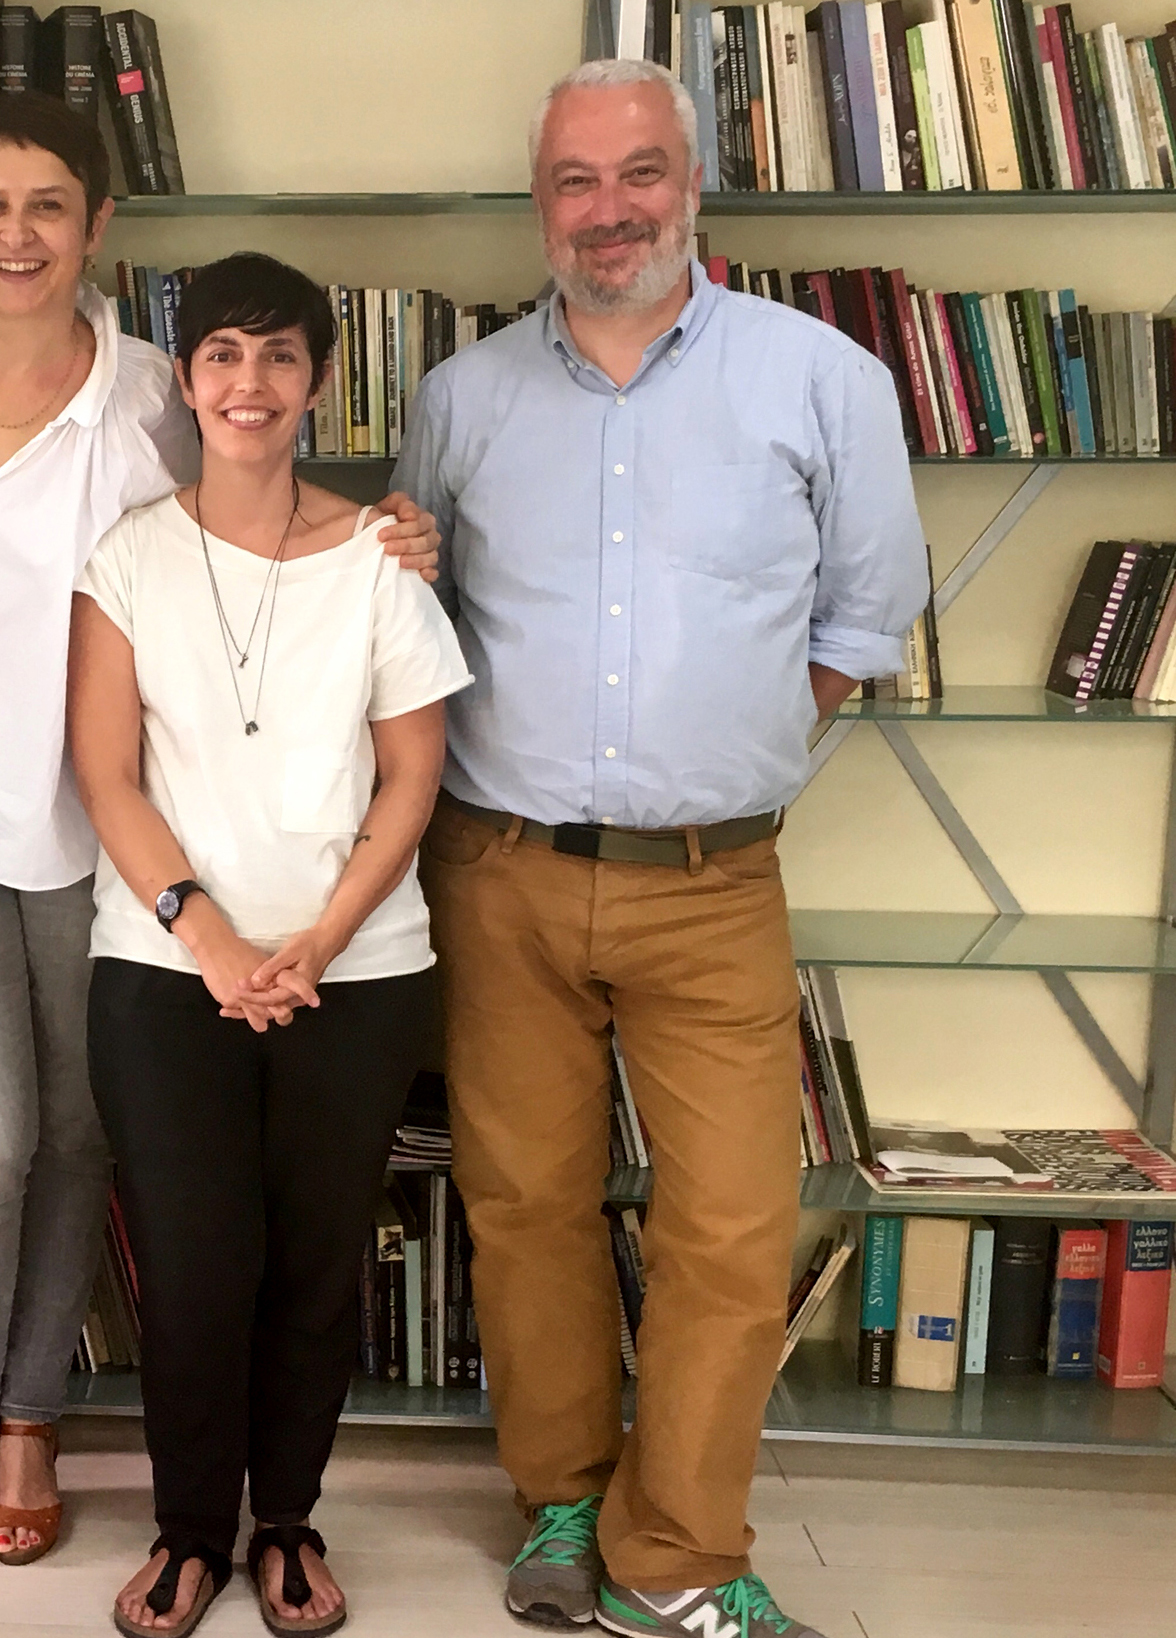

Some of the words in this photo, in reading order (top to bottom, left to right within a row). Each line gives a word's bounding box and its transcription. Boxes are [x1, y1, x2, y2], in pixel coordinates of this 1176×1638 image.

[115, 21, 133, 69] ACCIDENTAL
[129, 93, 143, 124] GENIUS
[162, 293, 173, 309] The
[386, 315, 394, 330] BACK
[902, 321, 912, 340] Gitai
[906, 340, 917, 360] Amos
[910, 361, 919, 372] de
[388, 376, 396, 401] JOURNEY
[912, 371, 922, 387] cine
[916, 387, 924, 396] El
[869, 1221, 886, 1306] SYNONYMES
[871, 1341, 881, 1372] ROBERT
[871, 1374, 880, 1383] LE
[679, 1601, 741, 1638] N
